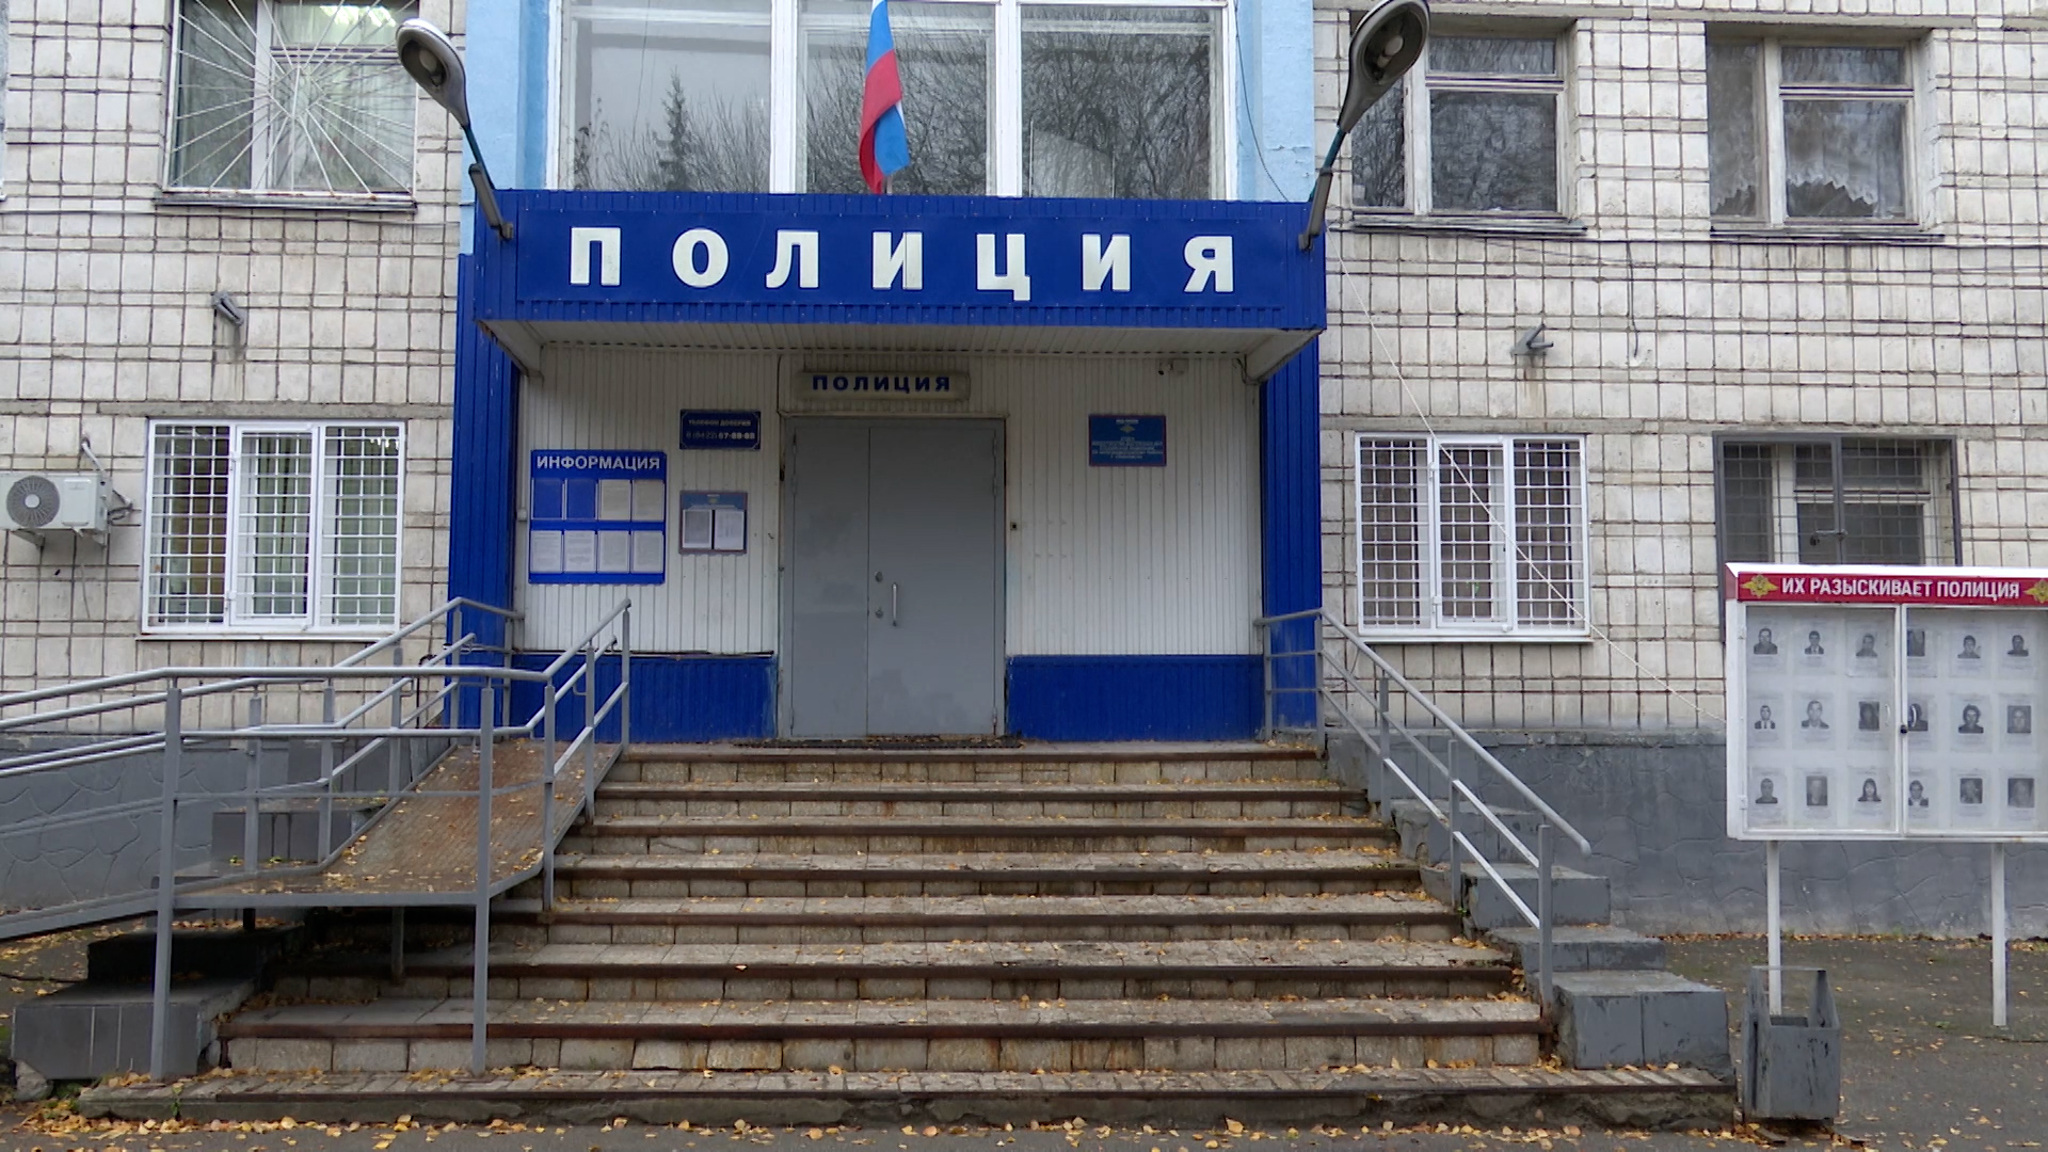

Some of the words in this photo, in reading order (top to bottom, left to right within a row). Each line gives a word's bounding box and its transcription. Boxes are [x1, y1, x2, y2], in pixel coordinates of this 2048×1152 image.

[569, 226, 1234, 302] ПОЛИЦИЯ
[812, 374, 951, 394] ПОЛИЦИЯ
[536, 455, 660, 471] ИНФОРМАЦИЯ
[1781, 577, 1804, 594] ИХ
[1809, 578, 1933, 598] РАЗЫСКИВАЕТ
[1936, 581, 2020, 601] ПОЛИЦИЯ
